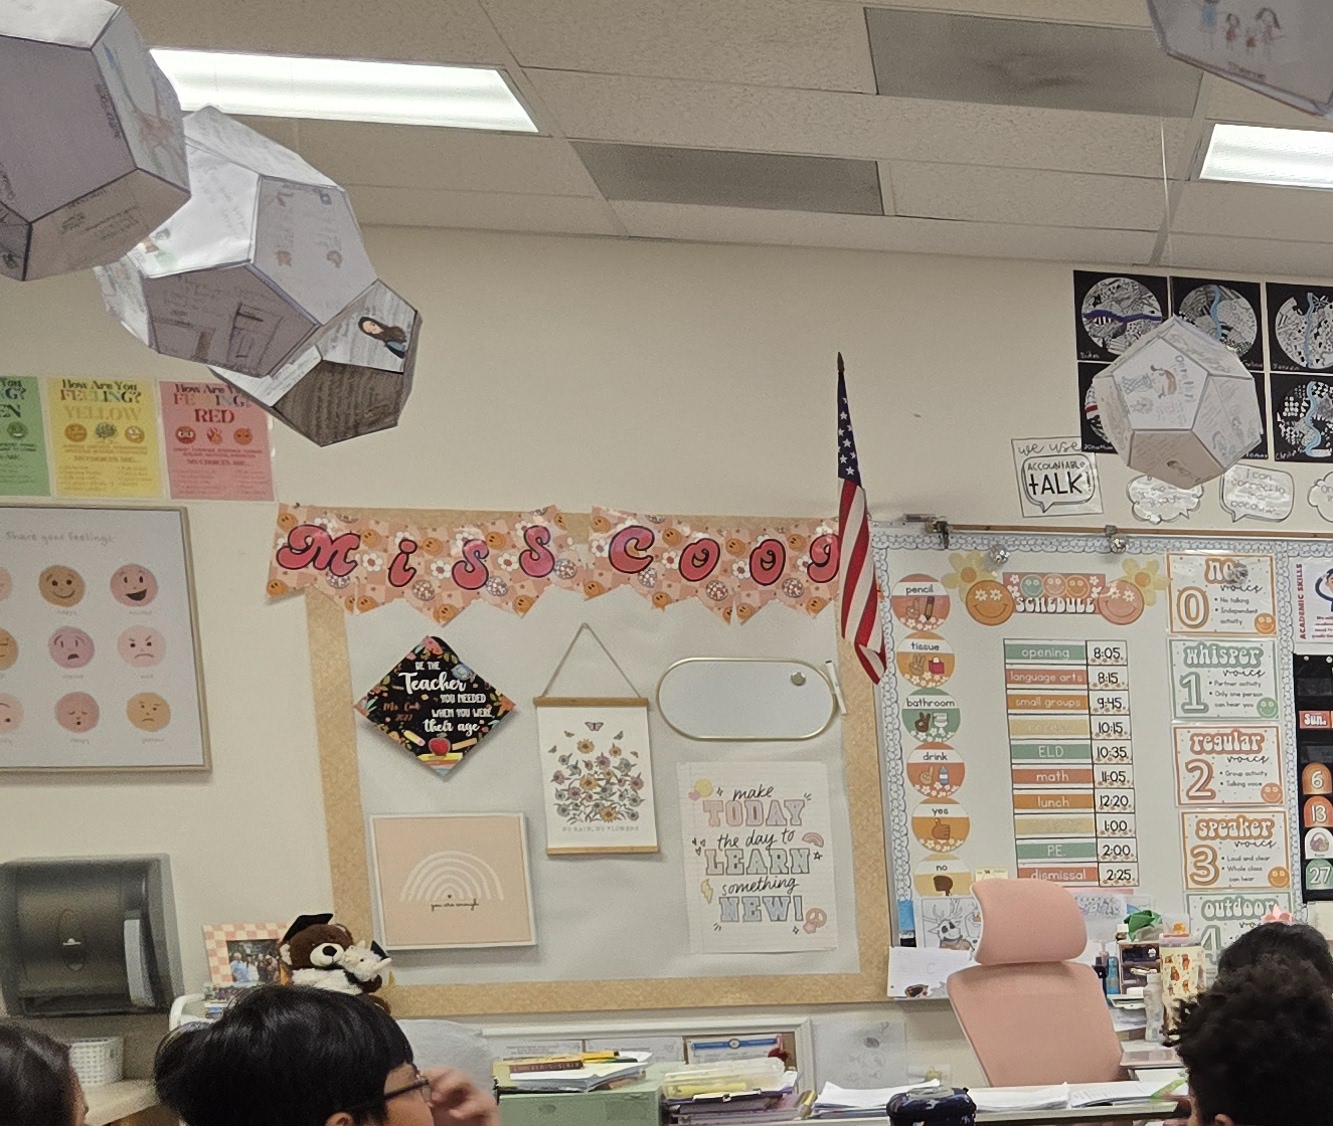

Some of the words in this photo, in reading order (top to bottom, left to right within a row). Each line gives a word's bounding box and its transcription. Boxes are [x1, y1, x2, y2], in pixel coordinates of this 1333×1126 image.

[64, 406, 142, 421] YELLOW
[194, 408, 235, 424] RED
[1296, 564, 1304, 593] SKILLS
[905, 584, 934, 596] pencil
[1015, 596, 1096, 614] SCHEDULE
[1298, 595, 1307, 640] ACADEMIC
[910, 641, 940, 652] tissue
[1021, 647, 1070, 660] opening
[1093, 646, 1121, 660] 8:05
[1186, 643, 1262, 667] whisper
[427, 661, 440, 671] THE
[398, 671, 467, 695] Teacher
[1009, 670, 1057, 685] language
[1059, 672, 1083, 683] arts
[1097, 671, 1119, 684] 8:15
[440, 693, 455, 705] YOU
[457, 693, 487, 704] NEEDED
[1180, 671, 1209, 714] 1
[905, 697, 956, 708] bathroom
[1015, 697, 1041, 708] small
[1044, 698, 1081, 711] groups
[1096, 697, 1123, 710] 9:45
[431, 708, 454, 718] WHEN
[455, 708, 471, 718] YOU
[1303, 713, 1327, 726] Sun.
[422, 718, 454, 733] their
[457, 721, 481, 737] age
[1098, 721, 1124, 734] 10:15
[1191, 730, 1264, 753] regular
[922, 751, 948, 761] drink
[1038, 745, 1064, 758] ELD
[1096, 746, 1128, 759] 10:35
[1035, 771, 1069, 782] math
[1101, 770, 1127, 783] 11:05
[1185, 758, 1216, 800] 2
[733, 784, 774, 801] make
[1037, 796, 1070, 808] lunch
[1099, 795, 1129, 807] 12:20
[702, 799, 806, 828] TODAY
[931, 807, 949, 817] yes
[1104, 820, 1128, 832] 1:00
[1197, 816, 1273, 840] speaker
[717, 833, 739, 850] the
[745, 829, 778, 850] day
[781, 828, 797, 844] to
[1102, 844, 1131, 857] 2:00
[704, 847, 811, 876] LEARN
[935, 863, 948, 872] no
[1189, 844, 1220, 886] 3
[1030, 869, 1086, 881] dismissal
[1106, 868, 1132, 881] 2:25
[1309, 866, 1331, 885] 27
[722, 875, 800, 896] something
[718, 895, 805, 923] NEW!
[1203, 898, 1275, 919] outdoor
